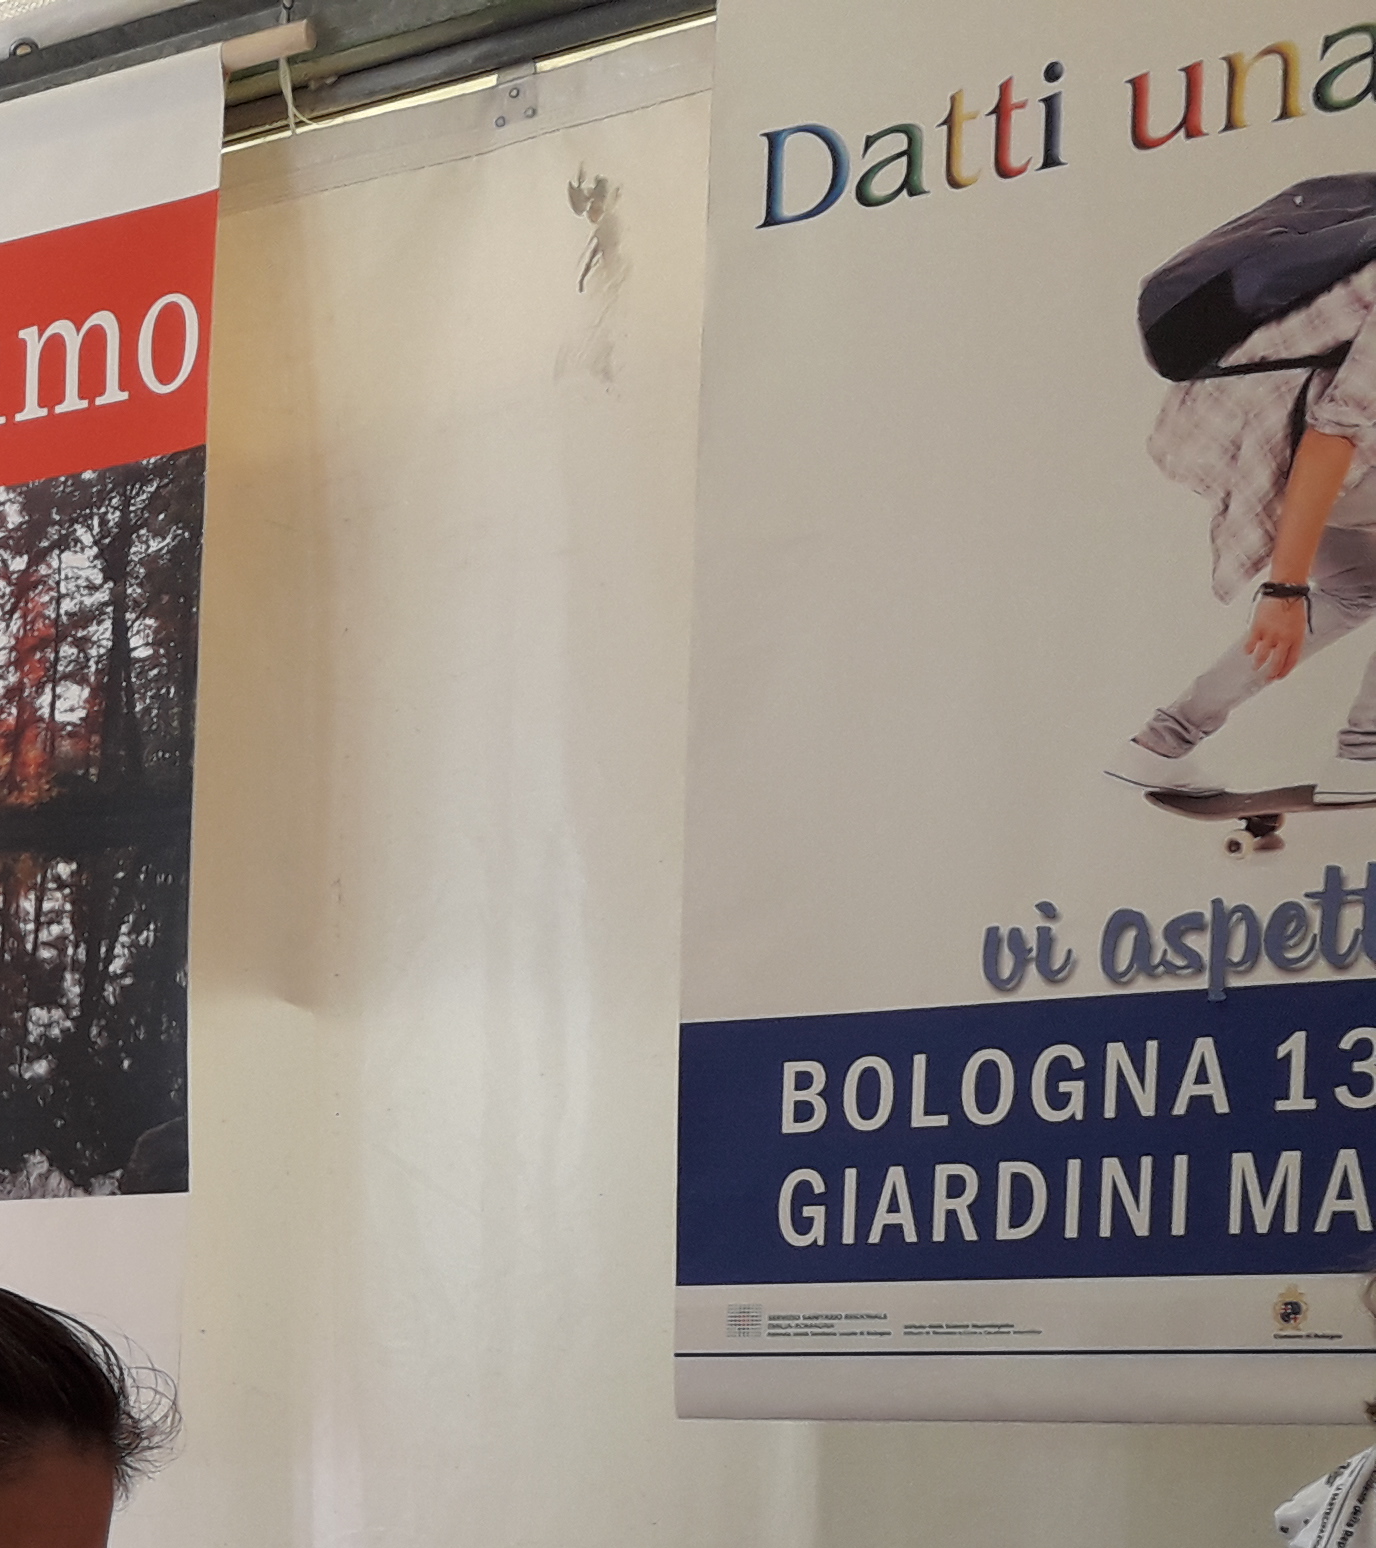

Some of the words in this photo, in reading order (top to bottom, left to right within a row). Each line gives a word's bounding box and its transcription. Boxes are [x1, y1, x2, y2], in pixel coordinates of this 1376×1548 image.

[756, 60, 1068, 230] Datti
[981, 900, 1074, 992] vi
[781, 1036, 1231, 1134] BOLOGNA
[1273, 1026, 1376, 1113] 13
[778, 1153, 1189, 1248] GIARDINI
[1227, 1148, 1376, 1235] MA
